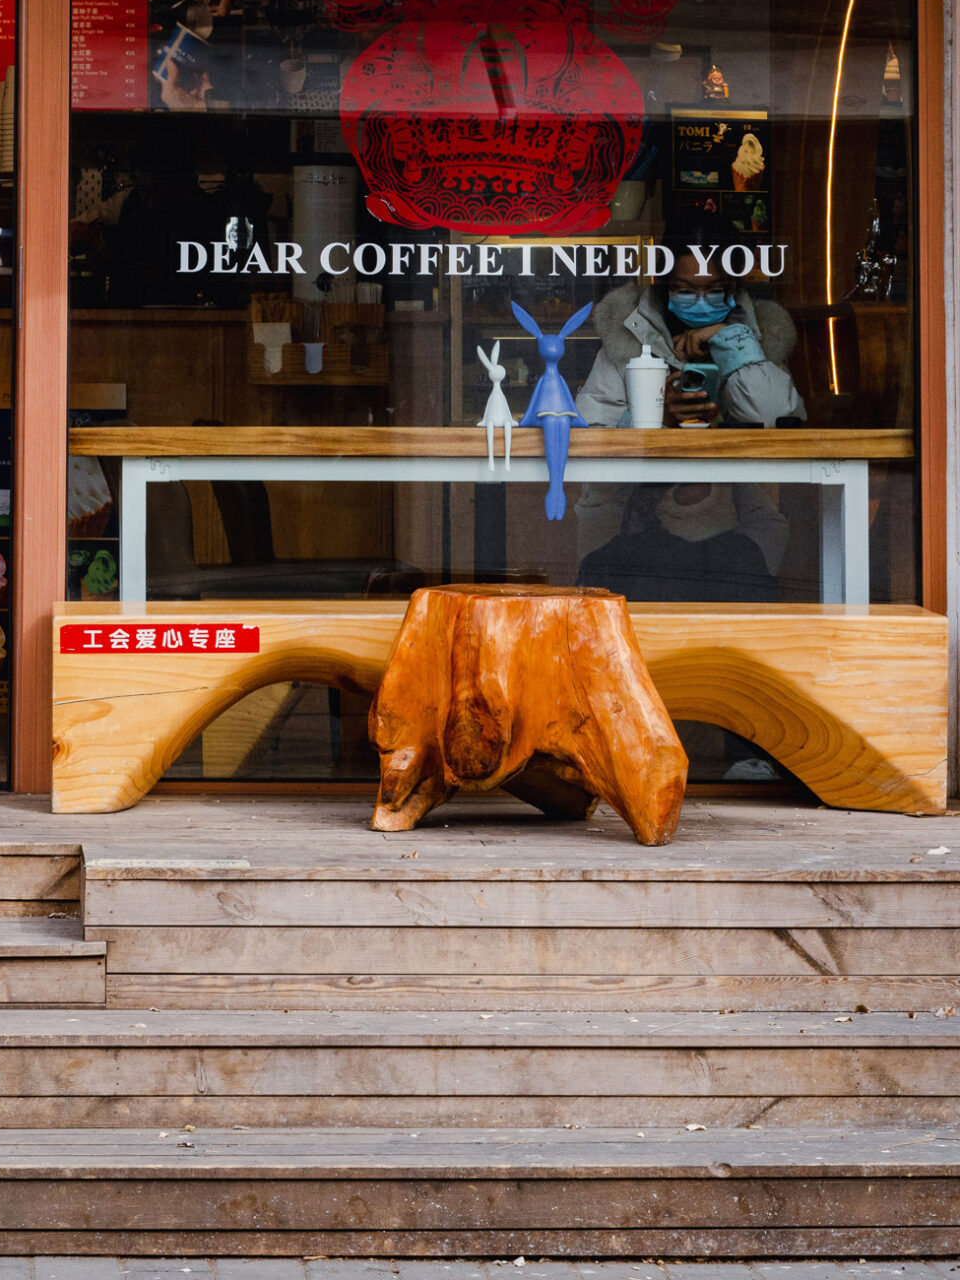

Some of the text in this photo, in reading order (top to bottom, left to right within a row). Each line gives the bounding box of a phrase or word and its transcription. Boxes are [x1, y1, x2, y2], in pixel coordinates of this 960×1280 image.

[678, 125, 712, 137] TOMI
[680, 140, 713, 153] バニラ
[176, 241, 790, 278] DEAR COFFEE I NEED YOU
[83, 628, 236, 650] 工会爱心专座
